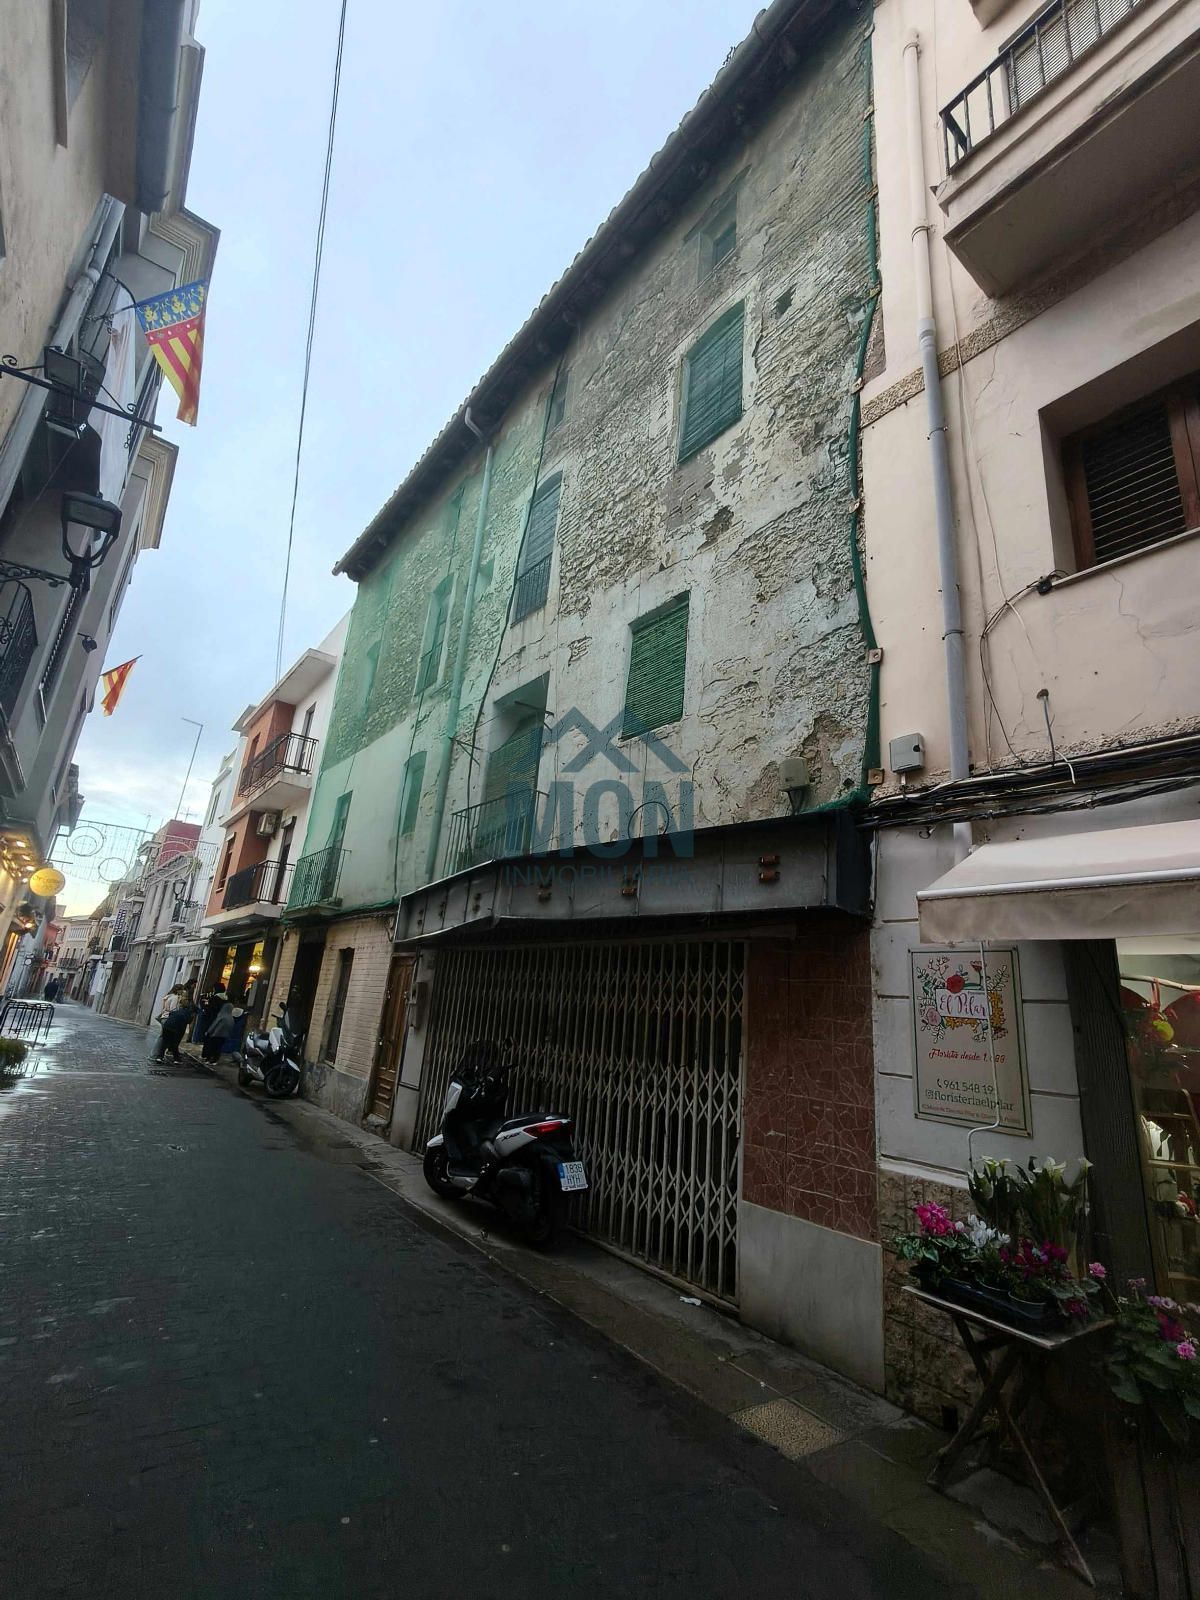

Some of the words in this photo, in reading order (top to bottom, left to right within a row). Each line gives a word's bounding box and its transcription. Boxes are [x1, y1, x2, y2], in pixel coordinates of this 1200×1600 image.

[939, 993, 952, 1015] El
[955, 992, 986, 1016] Pilar
[943, 1079, 960, 1090] 961
[962, 1081, 980, 1093] 548
